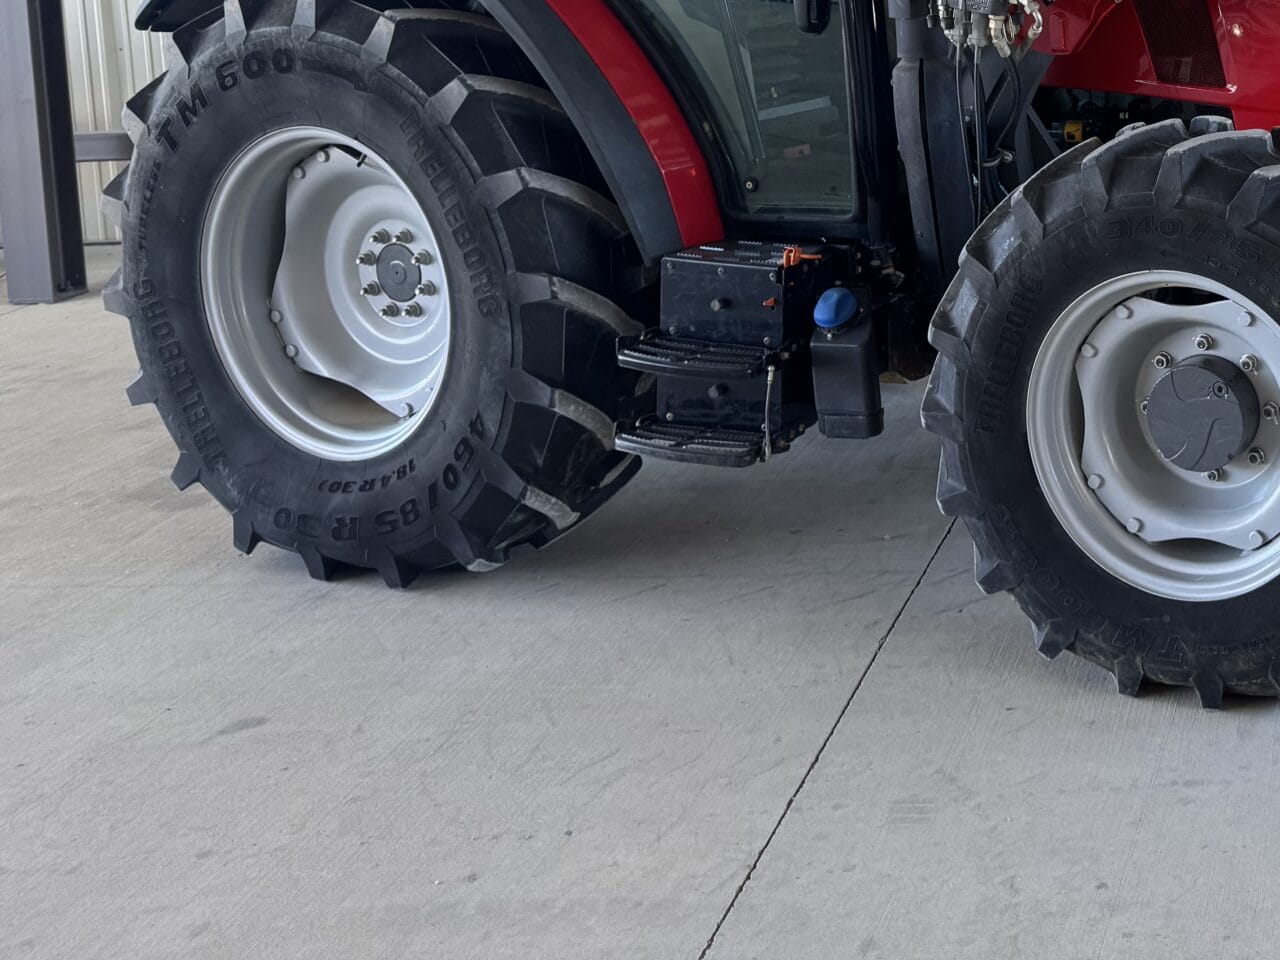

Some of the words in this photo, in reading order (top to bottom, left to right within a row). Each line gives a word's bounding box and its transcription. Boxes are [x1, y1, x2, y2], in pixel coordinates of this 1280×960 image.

[154, 80, 209, 154] TM
[215, 48, 296, 92] 600
[400, 107, 499, 318] TRELLEBORG
[132, 278, 227, 473] TRELLEBORG
